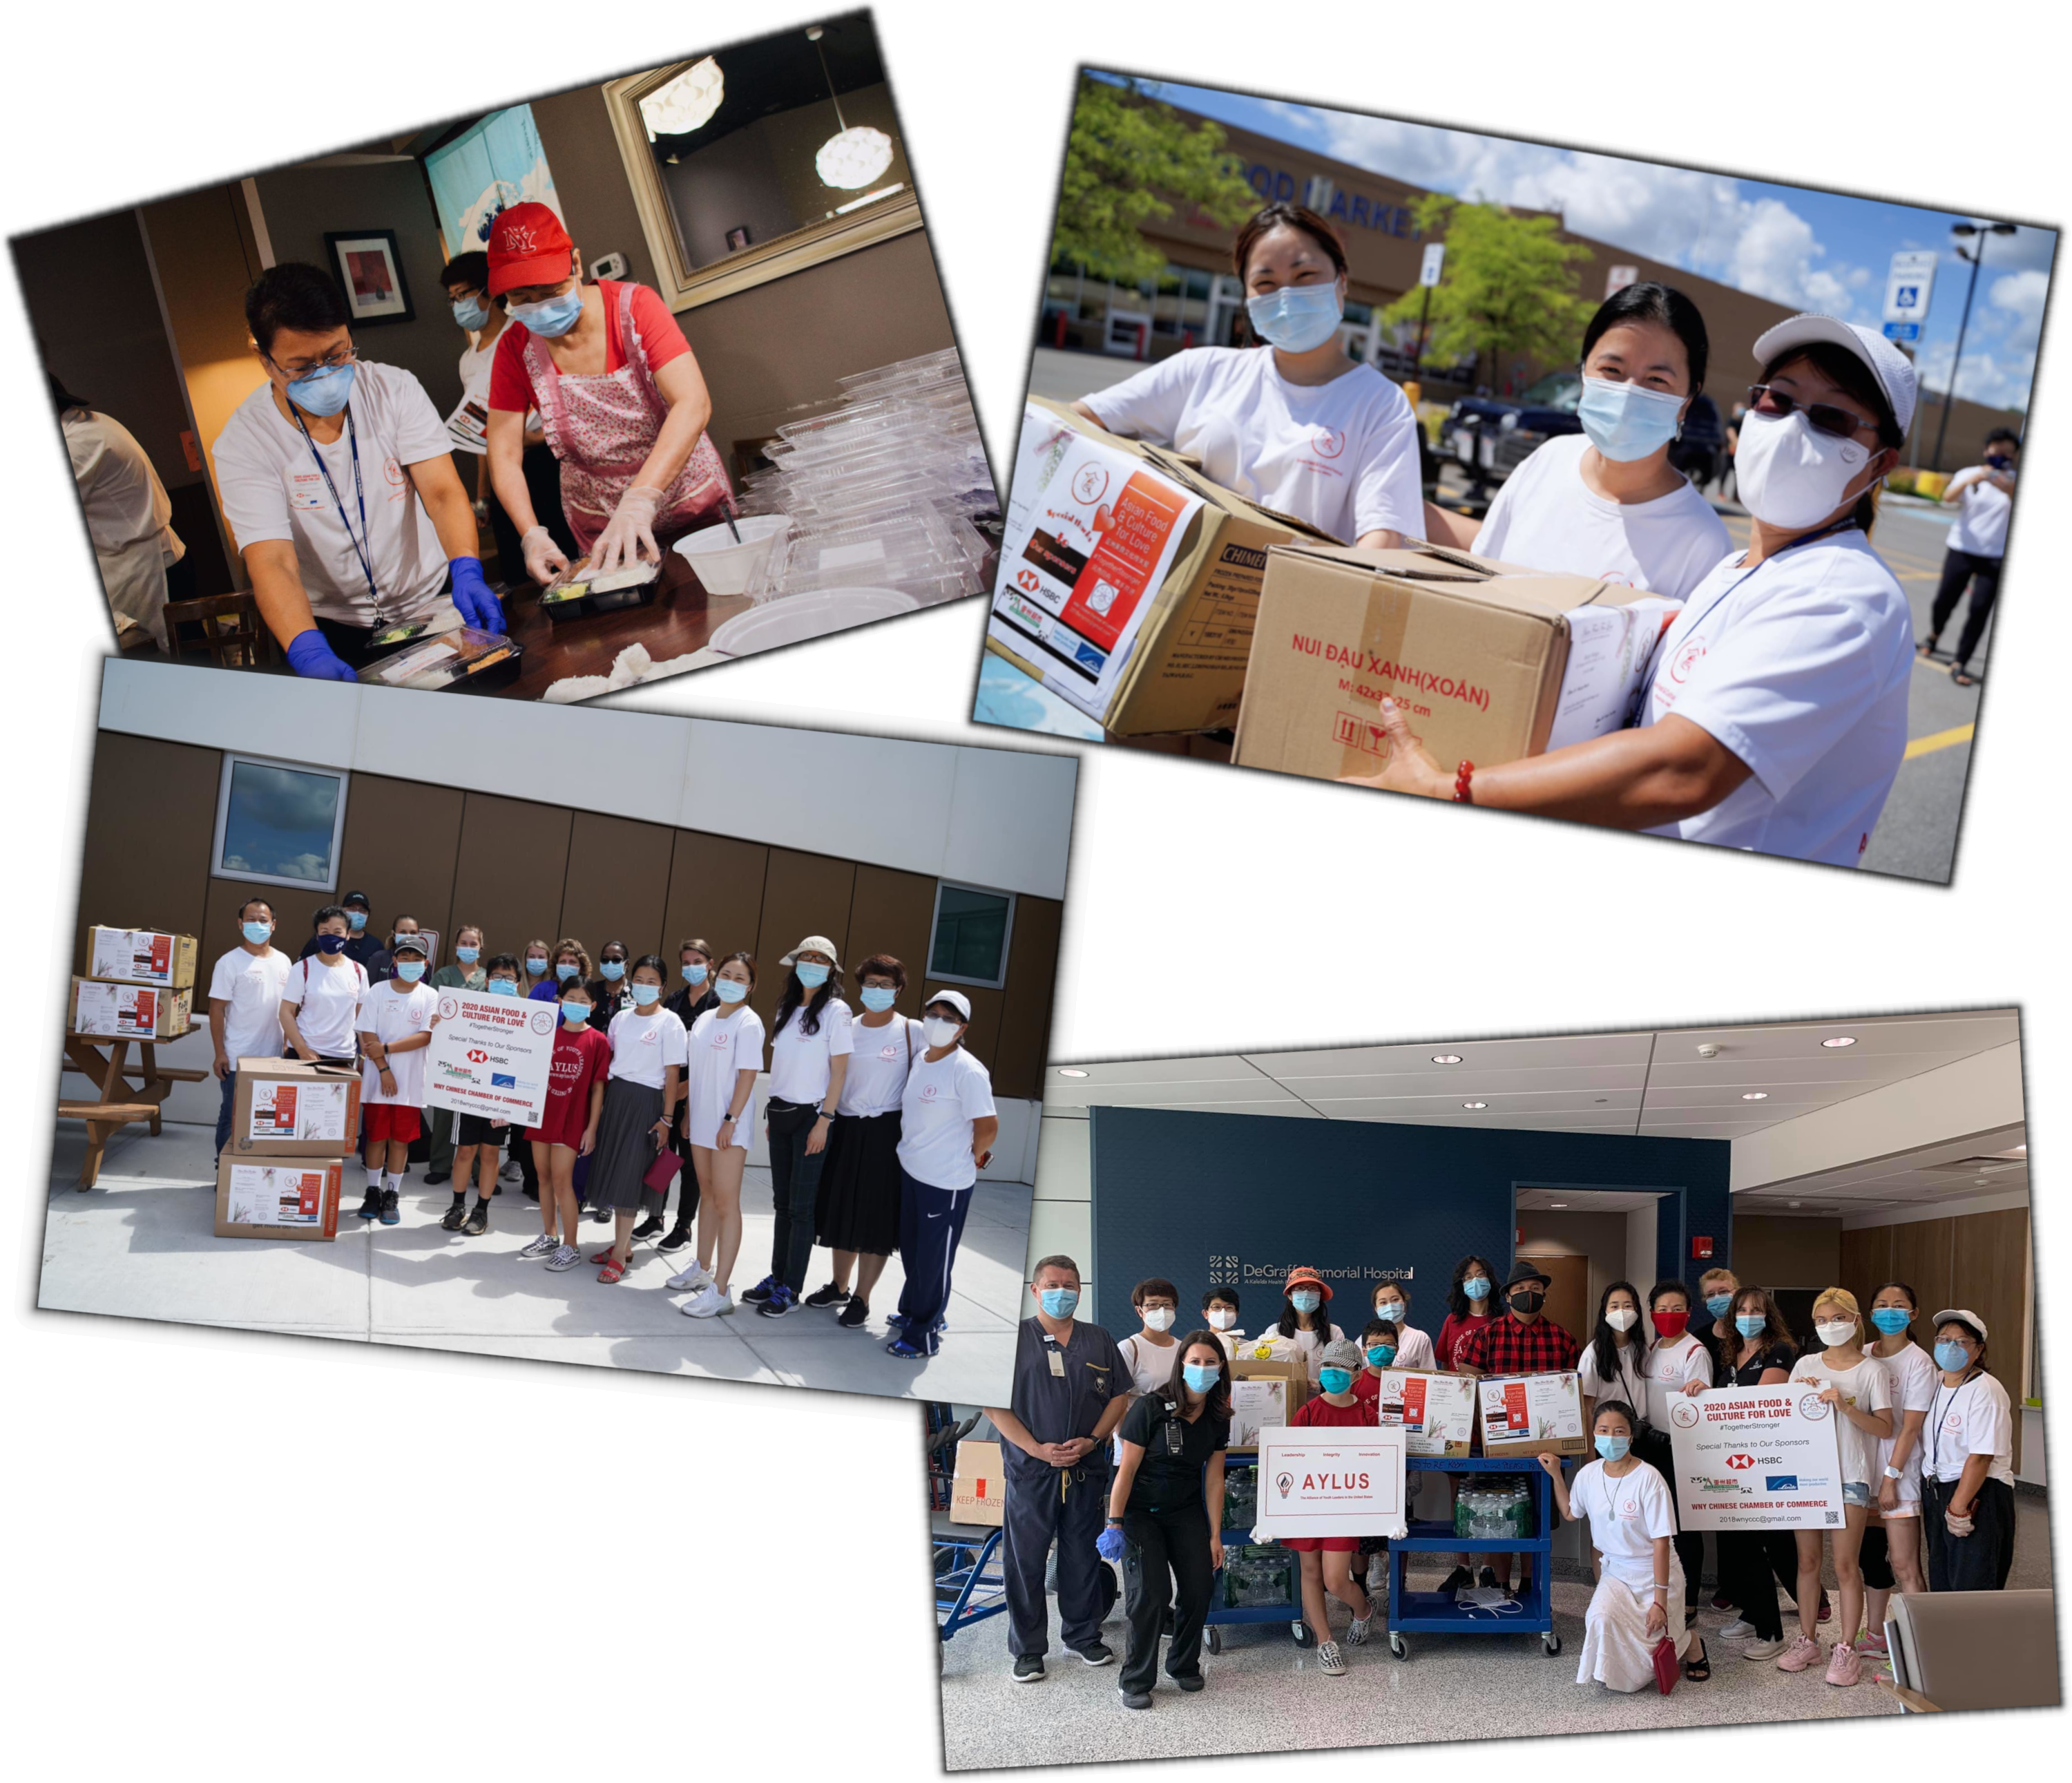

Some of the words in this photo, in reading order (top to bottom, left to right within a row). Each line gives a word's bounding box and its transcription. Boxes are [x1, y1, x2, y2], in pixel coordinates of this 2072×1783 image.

[503, 225, 537, 254] NY
[1046, 508, 1075, 522] Special
[1120, 497, 1144, 517] Asian
[1145, 510, 1169, 531] Food
[1117, 510, 1125, 522] &
[1126, 515, 1158, 542] Culture
[1115, 525, 1129, 540] for
[1129, 533, 1150, 553] Love
[1222, 546, 1267, 570] CHIMEI
[1039, 586, 1060, 603] HSBC
[1292, 633, 1321, 657] NUI
[1338, 678, 1354, 693] M:
[1412, 703, 1430, 717] cm
[461, 1002, 478, 1011] 2020
[479, 1004, 499, 1014] ASIAN
[501, 1008, 519, 1017] FOOD
[462, 1010, 490, 1021] CULTURE
[492, 1016, 505, 1024] FOR
[507, 1018, 524, 1027] LOVE
[469, 1022, 514, 1035] #TogetherStronger
[448, 1033, 467, 1042] Special
[468, 1037, 486, 1045] Thanks
[506, 1044, 532, 1053] Sponsors
[566, 1046, 582, 1056] YOUTH
[489, 1056, 508, 1065] HSBC
[550, 1062, 579, 1073] AYLUS
[445, 1085, 466, 1094] CHINESE
[468, 1089, 493, 1099] CHAMBER
[502, 1096, 533, 1107] COMMERCE
[450, 1098, 510, 1114] 2018wnyccc@gmail.com
[1310, 1266, 1359, 1278] emorial
[1364, 1267, 1413, 1280] Hospital
[1704, 1403, 1725, 1412] 2020
[1728, 1401, 1755, 1410] ASIAN
[1758, 1399, 1783, 1409] FOOD
[1785, 1398, 1792, 1407] &
[1707, 1412, 1745, 1422] CULTURE
[1748, 1411, 1765, 1419] FOR
[1768, 1409, 1792, 1418] LOVE
[1720, 1422, 1781, 1431] #TogetherStronger
[1775, 1439, 1810, 1447] Sponsors
[1758, 1456, 1783, 1465] HSBC
[1302, 1473, 1370, 1490] AYLUS
[957, 1496, 975, 1505] KEEP
